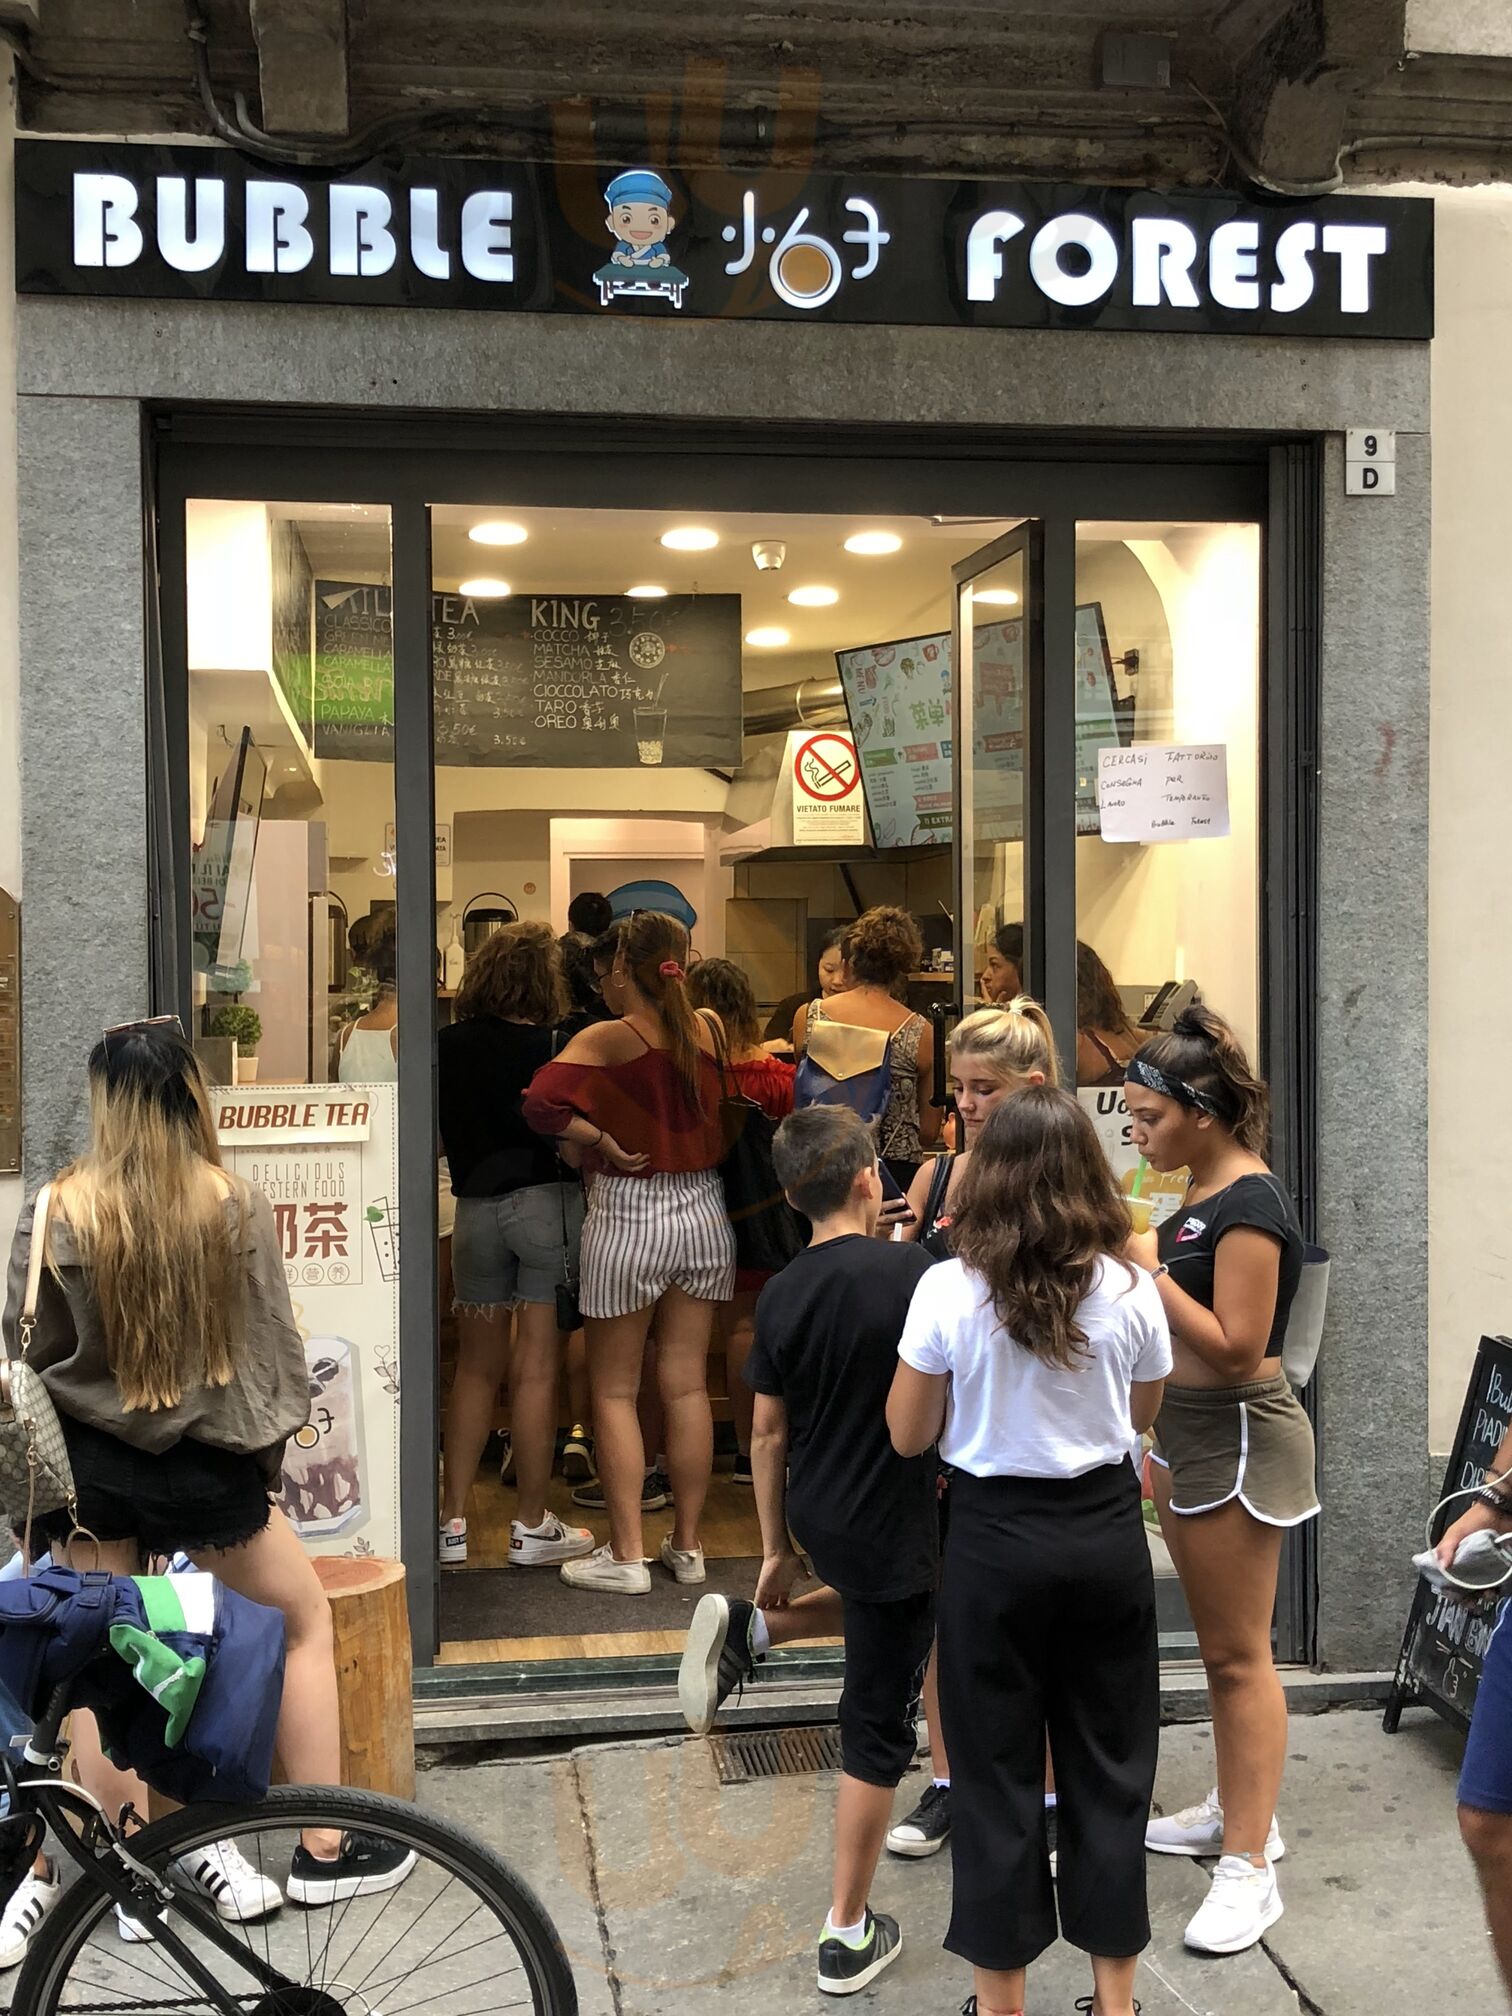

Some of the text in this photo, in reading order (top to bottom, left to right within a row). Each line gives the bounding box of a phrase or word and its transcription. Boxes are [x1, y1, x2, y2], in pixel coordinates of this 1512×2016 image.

[73, 172, 515, 284] BUBBLE
[966, 210, 1388, 313] FOREST
[1364, 435, 1377, 457] 9
[1362, 467, 1379, 489] D
[431, 595, 480, 626] TEA
[531, 599, 601, 631] KING
[324, 613, 392, 633] CLASSICO
[533, 629, 580, 642] COCCO
[533, 643, 591, 657] MATCHA
[534, 656, 593, 669] SESAMO
[533, 670, 607, 685] MANDORLA
[533, 683, 618, 698] CIOCCOLATO
[321, 703, 375, 721] PAPAYA
[534, 699, 577, 714] TARO
[534, 713, 578, 729] OREO
[796, 804, 861, 813] VIETATO FUMARE
[218, 1102, 370, 1130] BUBBLE TEA
[252, 1161, 345, 1182] DELICIOUS
[314, 1179, 345, 1198] FOOD
